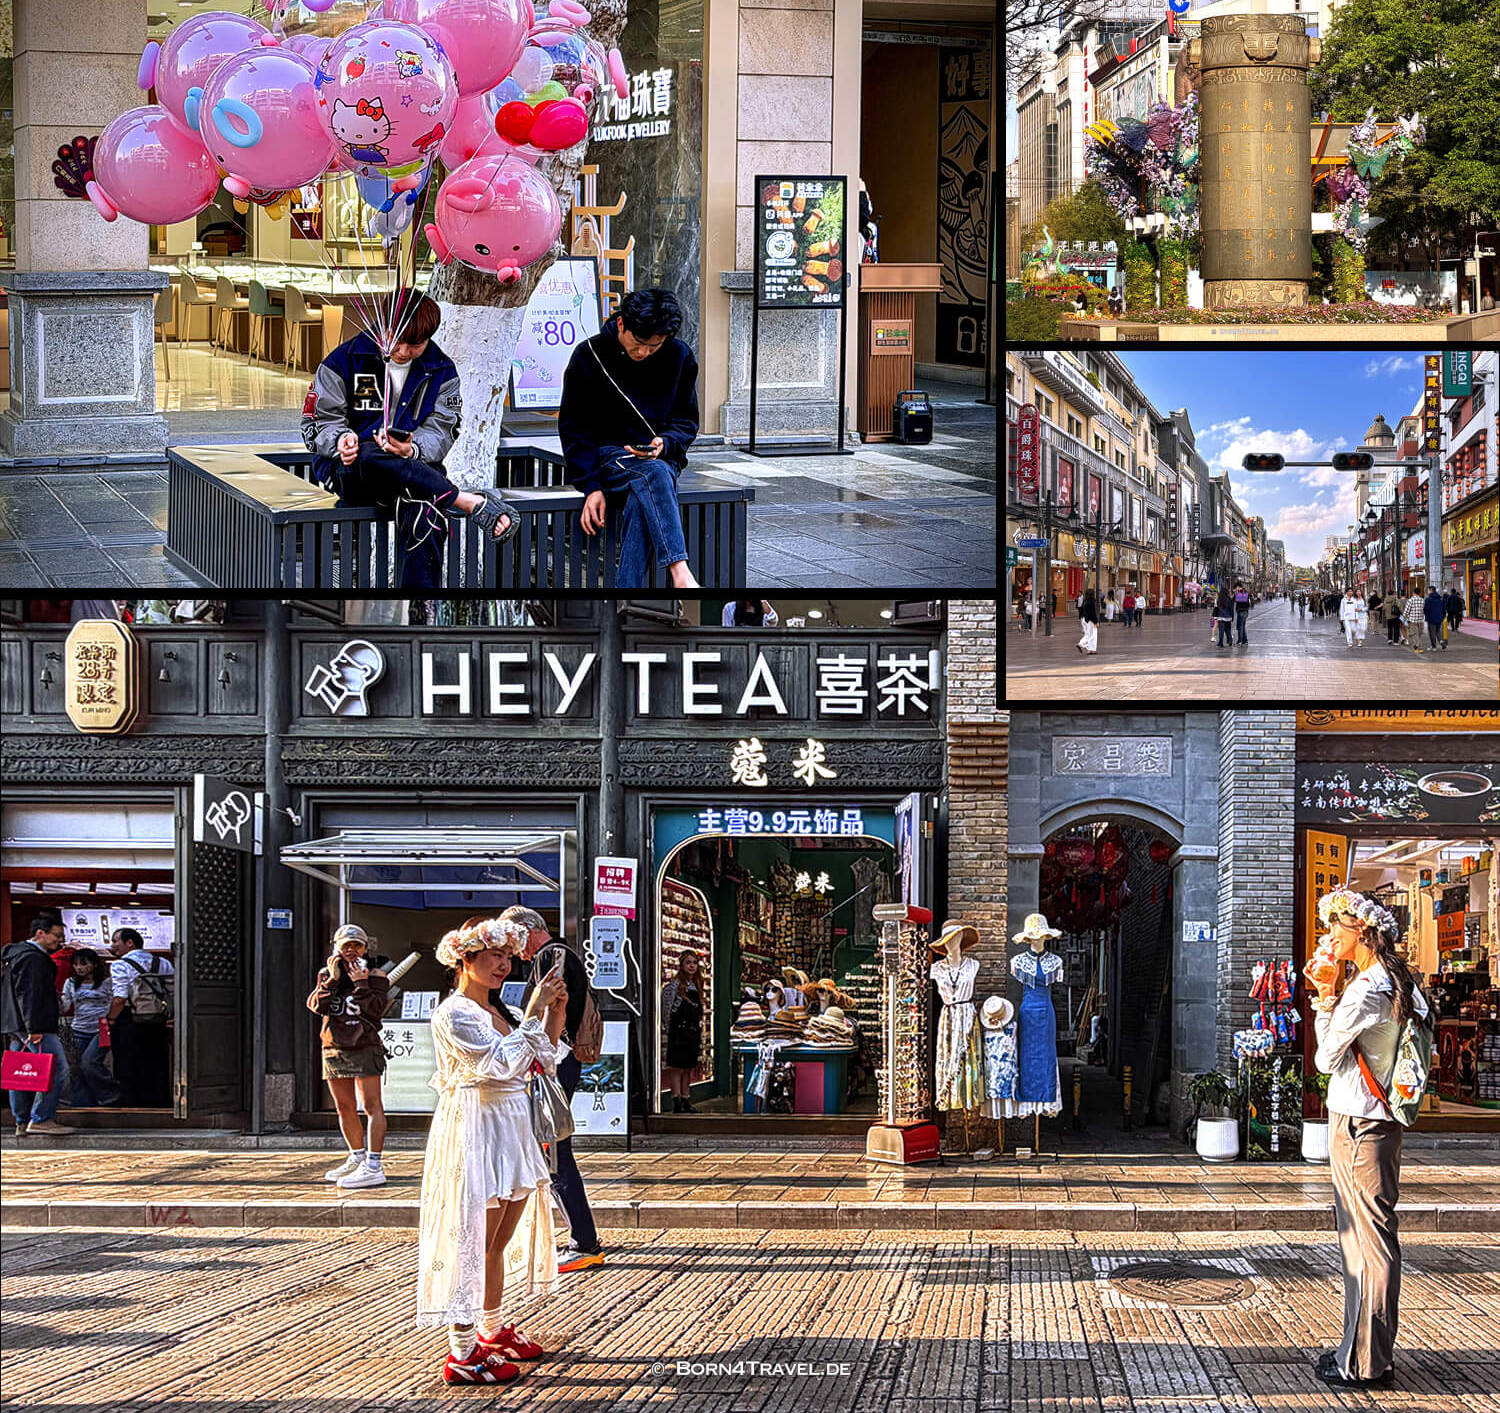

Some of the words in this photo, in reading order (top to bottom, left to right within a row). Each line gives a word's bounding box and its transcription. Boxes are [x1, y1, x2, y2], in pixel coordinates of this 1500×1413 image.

[544, 321, 576, 345] 80
[422, 652, 597, 714] HEY
[622, 652, 788, 714] TEA
[815, 653, 929, 716] 喜茶
[698, 808, 864, 835] 主营9.9元饰品
